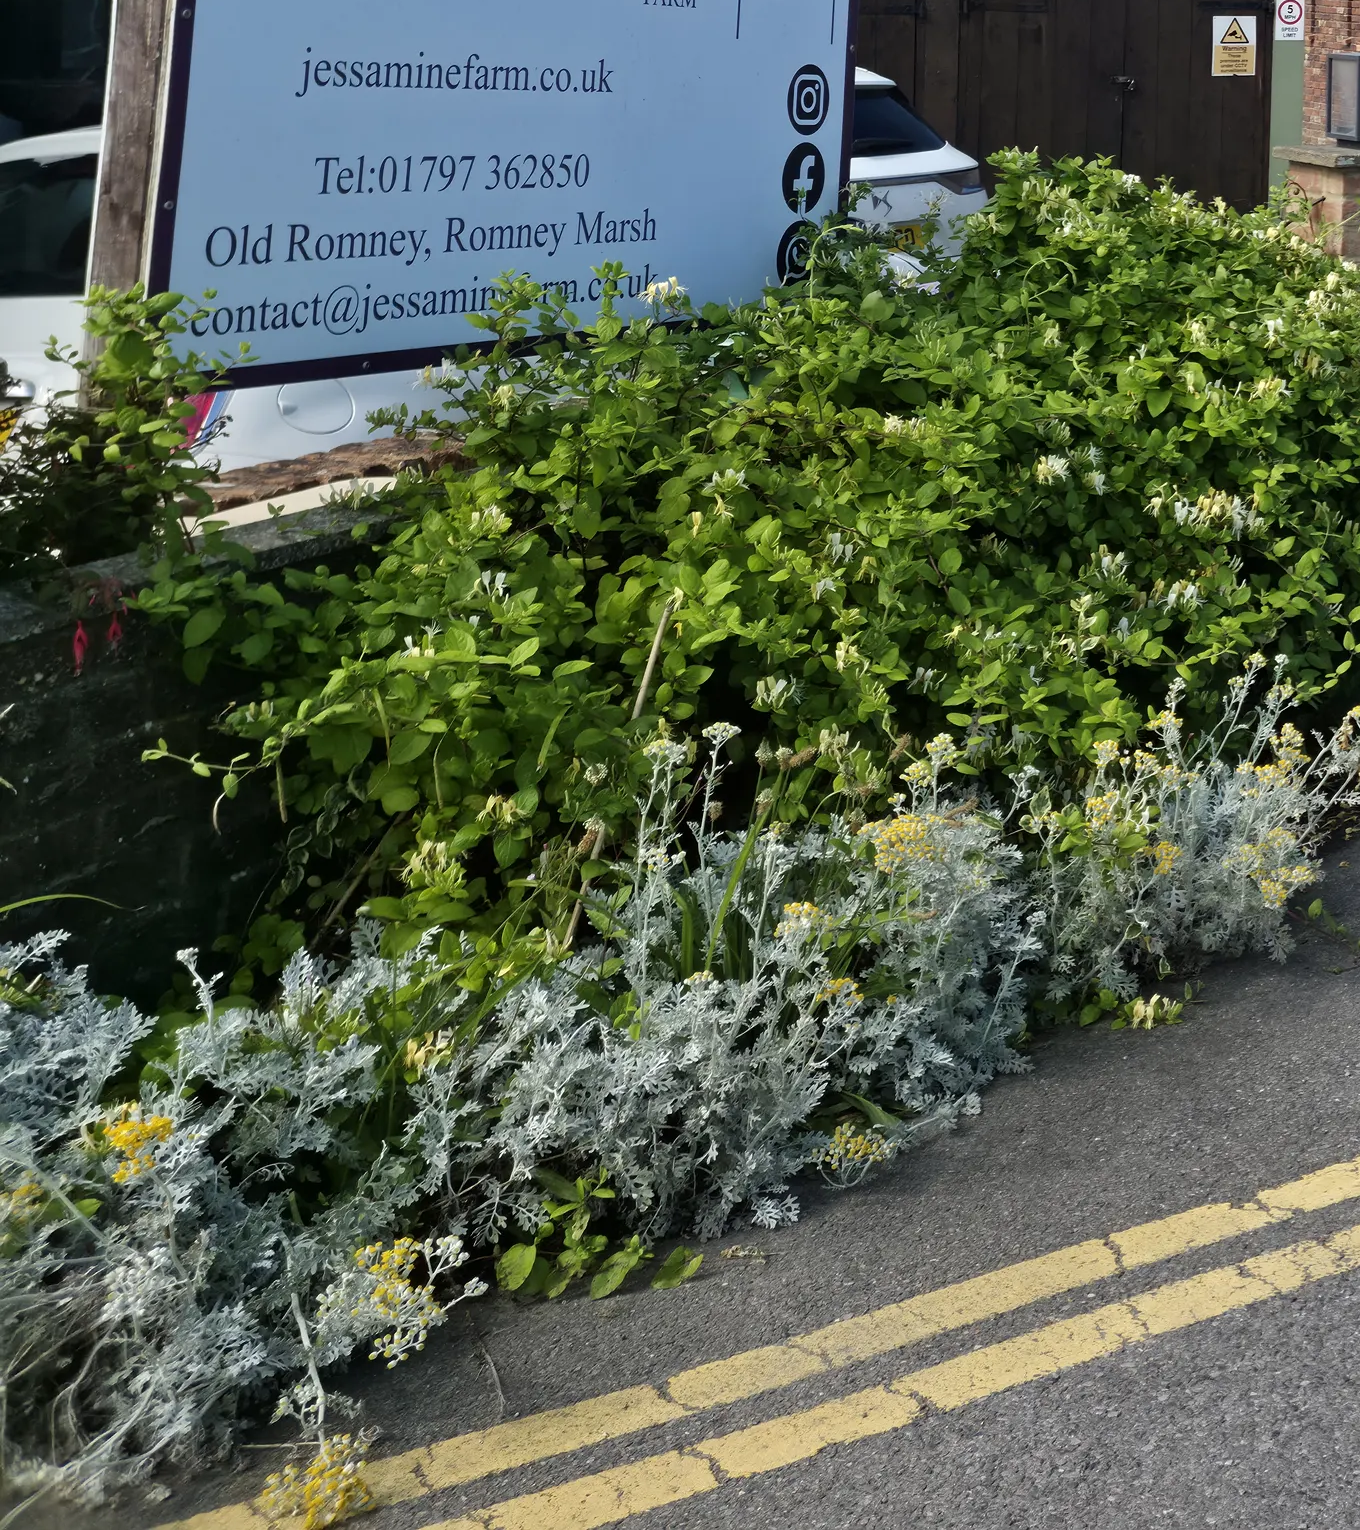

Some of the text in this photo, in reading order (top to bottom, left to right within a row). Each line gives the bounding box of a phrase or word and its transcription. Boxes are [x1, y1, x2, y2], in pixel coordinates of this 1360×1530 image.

[1287, 5, 1293, 13] 5
[295, 46, 615, 98] jessaminefarm.co.uk
[314, 153, 590, 195] Tel:01797 362850
[205, 207, 658, 268] Old Romney, Romney Marsh
